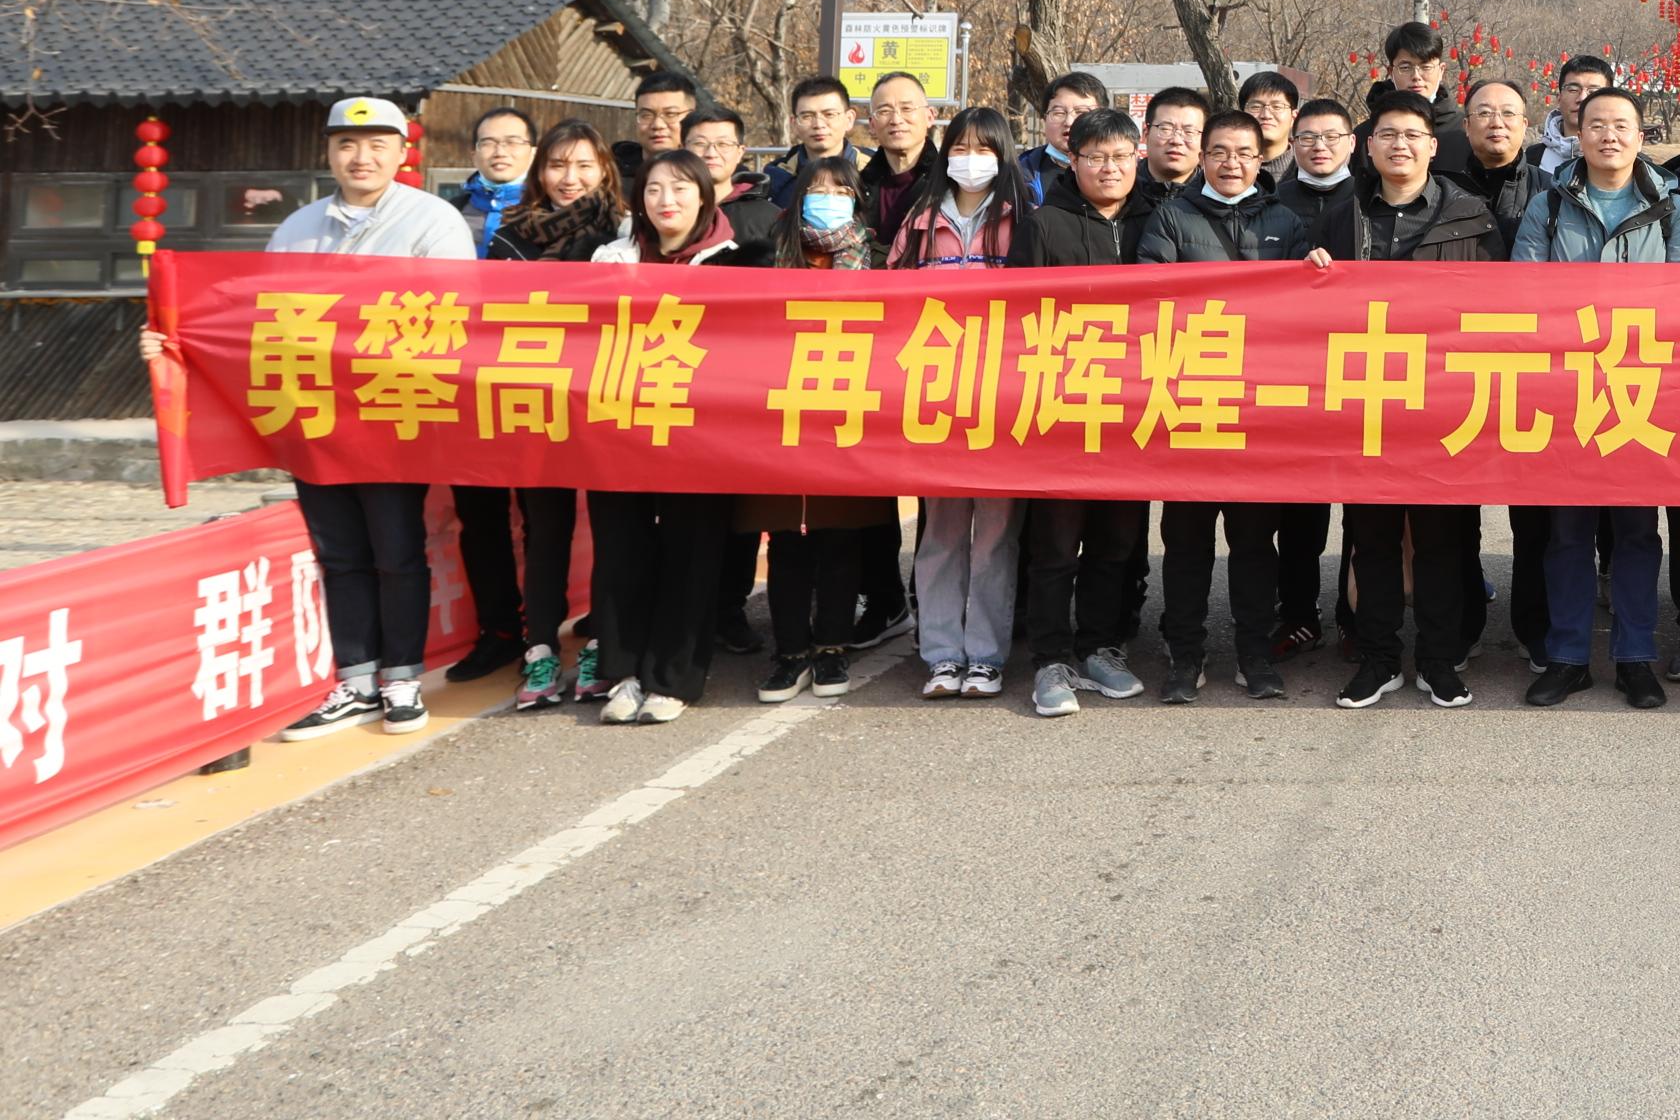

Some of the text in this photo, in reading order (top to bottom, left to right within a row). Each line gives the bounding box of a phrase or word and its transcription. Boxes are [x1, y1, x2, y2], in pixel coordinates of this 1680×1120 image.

[881, 40, 900, 60] 黄
[246, 290, 708, 447] 勇攀高峰
